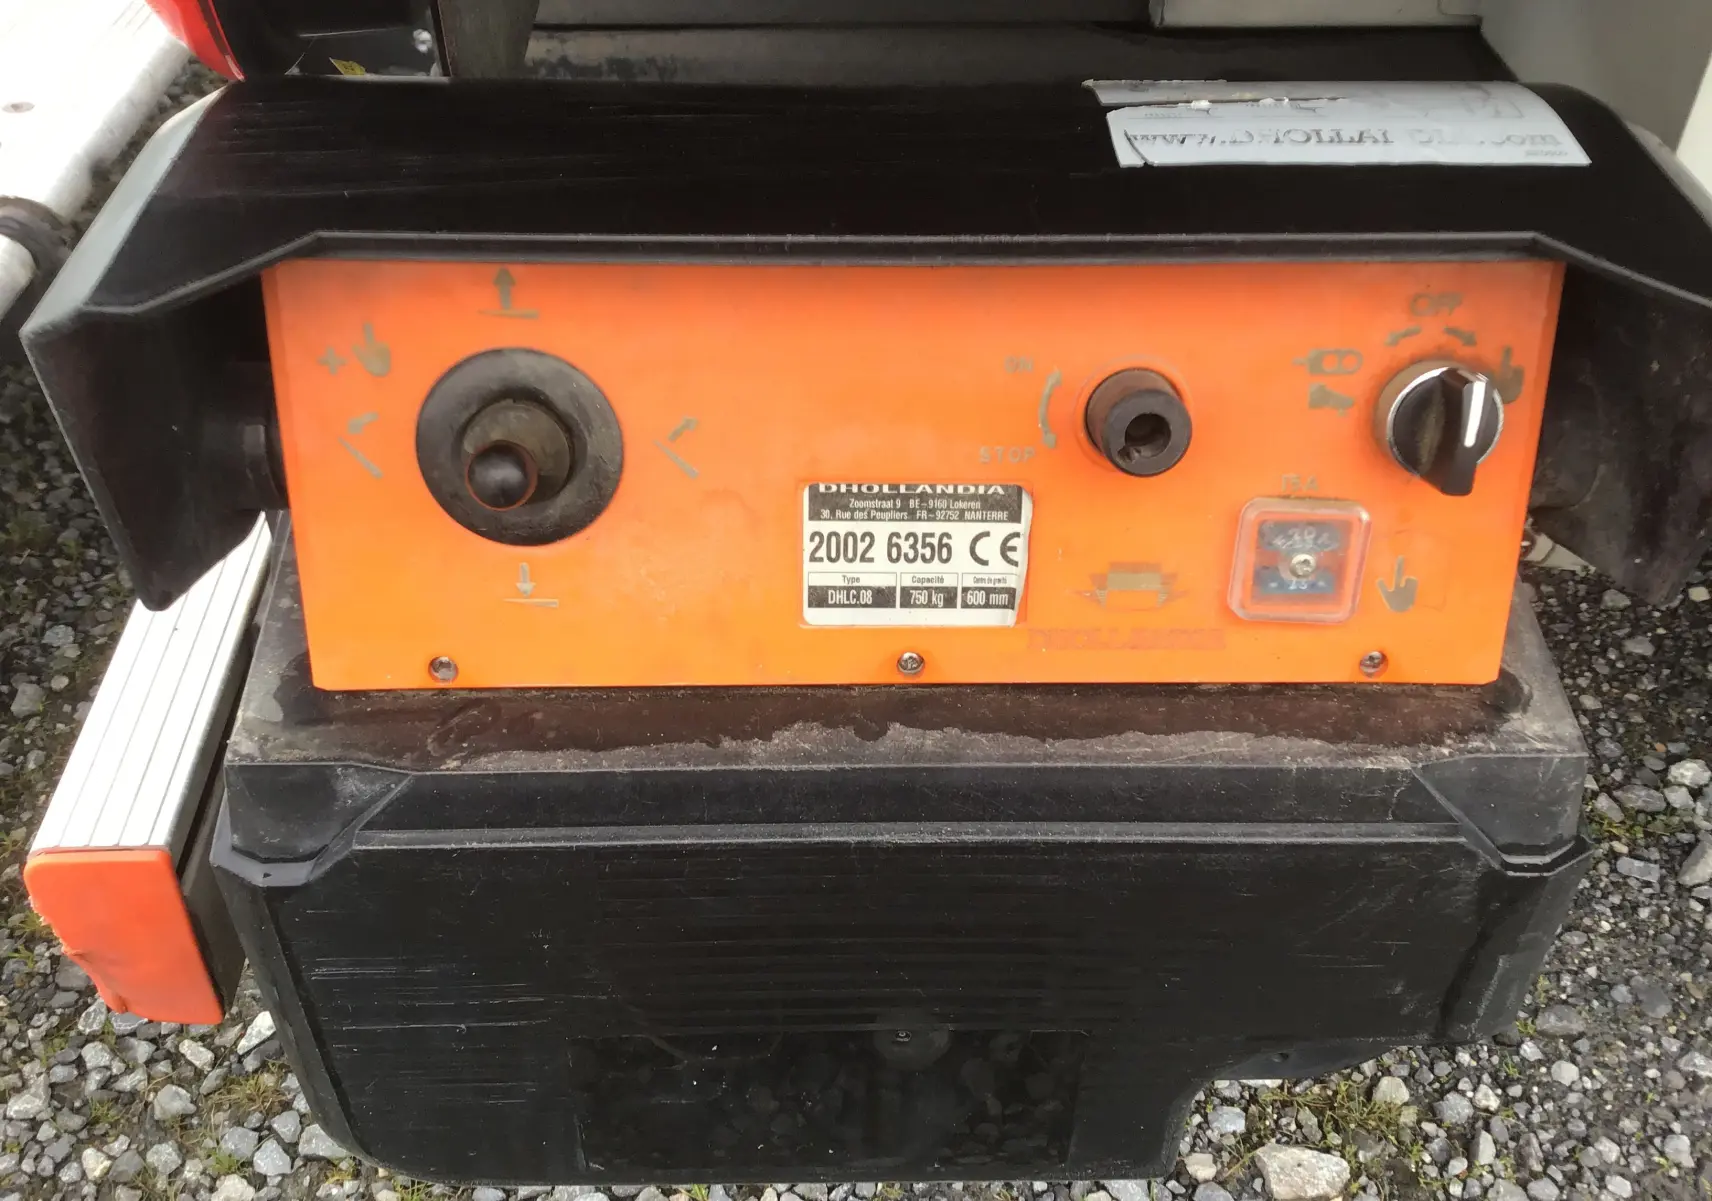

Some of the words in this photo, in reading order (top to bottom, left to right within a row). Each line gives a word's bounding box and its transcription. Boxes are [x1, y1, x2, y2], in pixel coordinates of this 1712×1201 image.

[978, 445, 1036, 465] STOP
[819, 483, 1005, 495] DHOLLANDIA
[849, 498, 894, 509] Zoomstraat
[895, 499, 901, 509] 9
[949, 500, 981, 510] Lokeren
[835, 510, 852, 519] Rue
[853, 510, 868, 520] des
[870, 510, 908, 521] Peupliers
[964, 511, 1009, 521] NANTERRE
[809, 531, 875, 563] 2002
[886, 531, 953, 564] 6356
[842, 575, 860, 584] Type
[911, 575, 944, 584] Capacité
[828, 590, 873, 604] DHLC.08
[909, 590, 928, 605] 750
[931, 590, 944, 607] kg
[966, 590, 986, 605] 600
[989, 593, 1009, 605] mm
